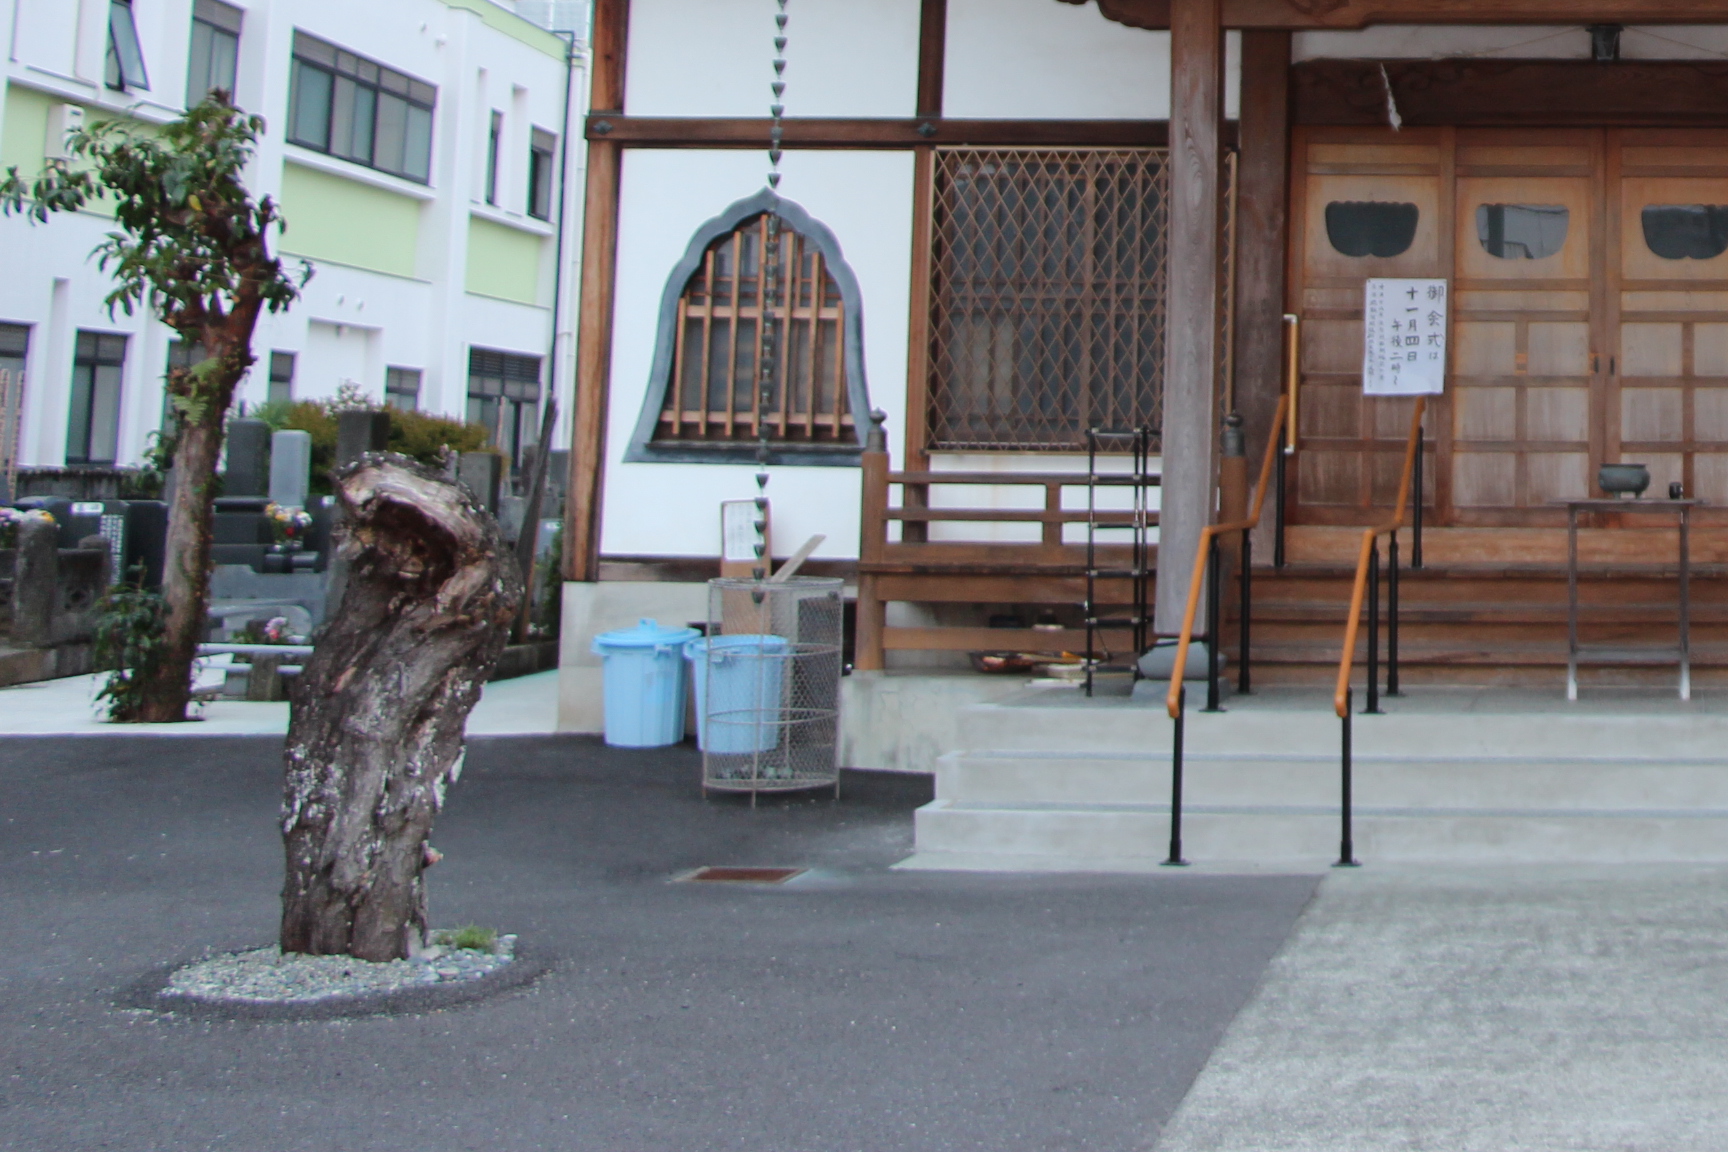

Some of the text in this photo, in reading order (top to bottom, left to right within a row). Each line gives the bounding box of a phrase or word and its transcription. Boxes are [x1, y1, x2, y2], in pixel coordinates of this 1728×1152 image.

[1405, 286, 1420, 362] 十一月四日
[1427, 284, 1445, 360] 御会式は
